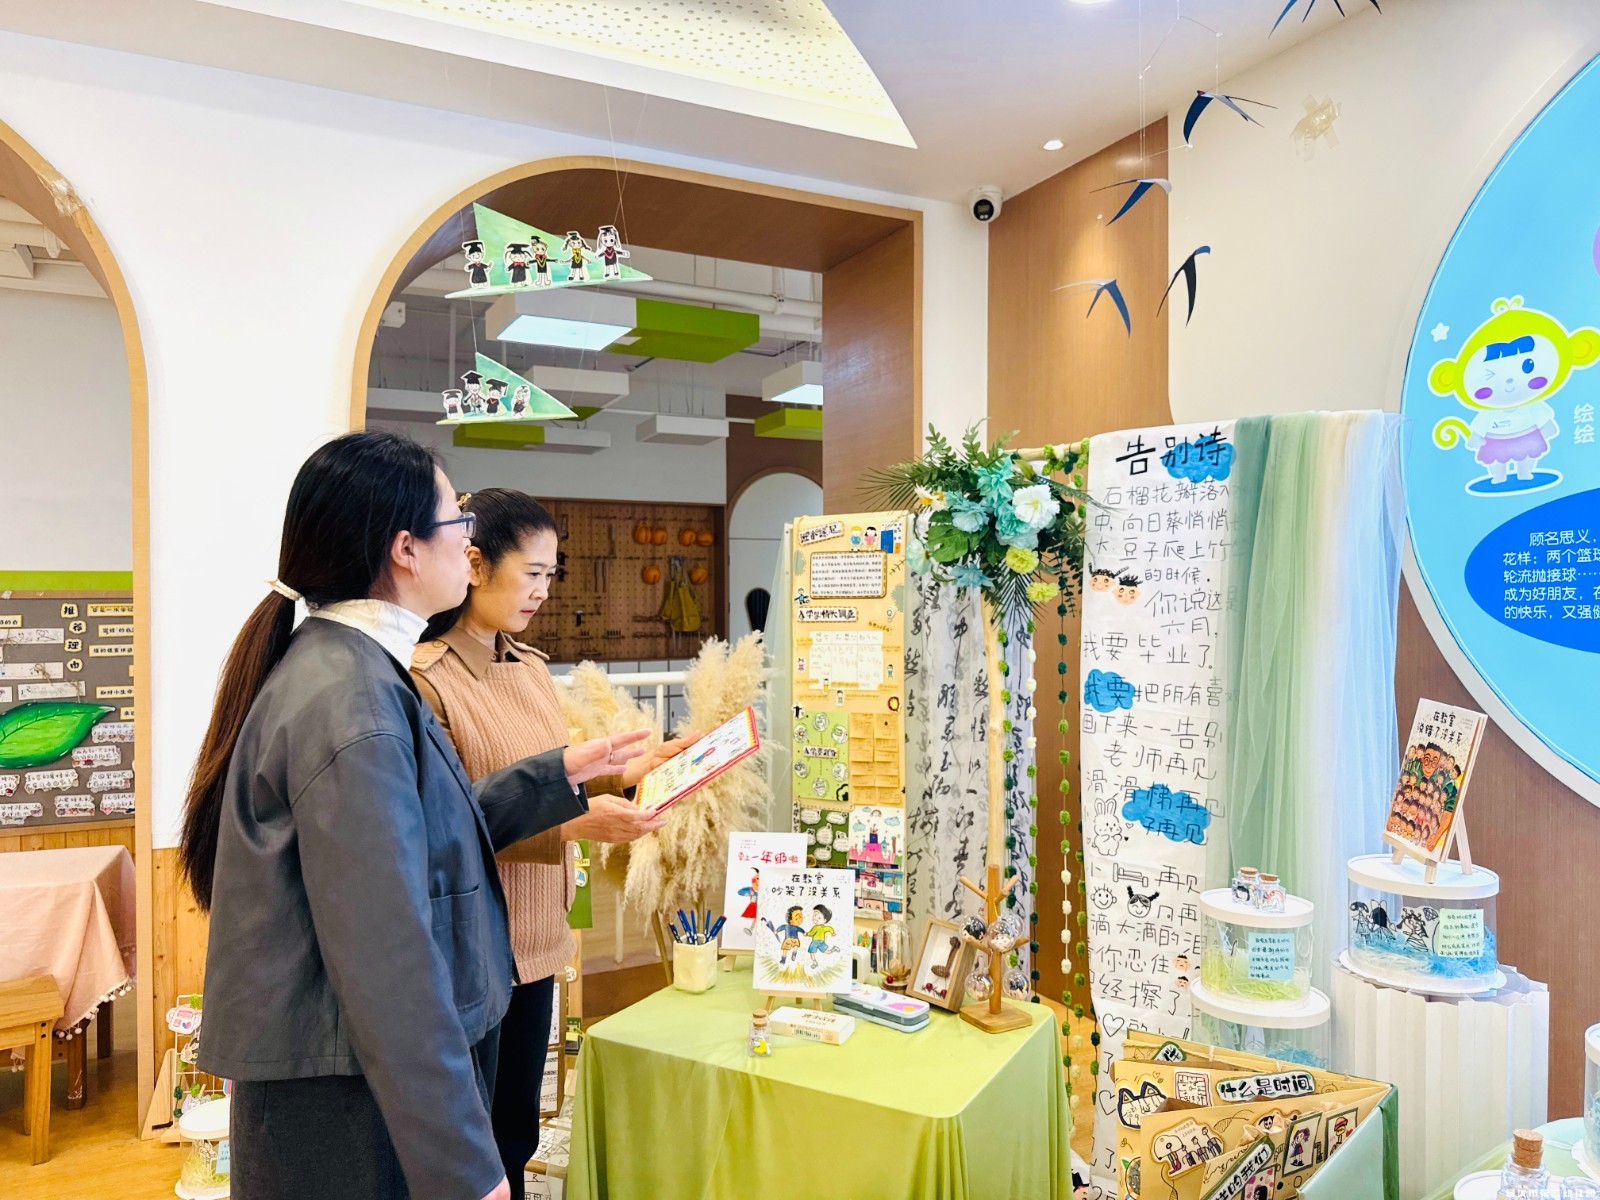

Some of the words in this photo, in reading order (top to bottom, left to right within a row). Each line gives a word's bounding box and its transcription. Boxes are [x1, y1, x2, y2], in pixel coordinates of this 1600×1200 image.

[1115, 425, 1227, 476] 告别诗
[1529, 528, 1596, 547] 顾名思义，
[1083, 631, 1214, 669] 我要毕业了。
[1432, 711, 1456, 728] 在教室
[1103, 740, 1217, 780] 老师再见
[1086, 769, 1226, 818] 滑滑梯再见
[791, 871, 825, 885] 在教室
[771, 885, 842, 899] 吵架了没关系
[1220, 1073, 1313, 1099] 什么是时间
